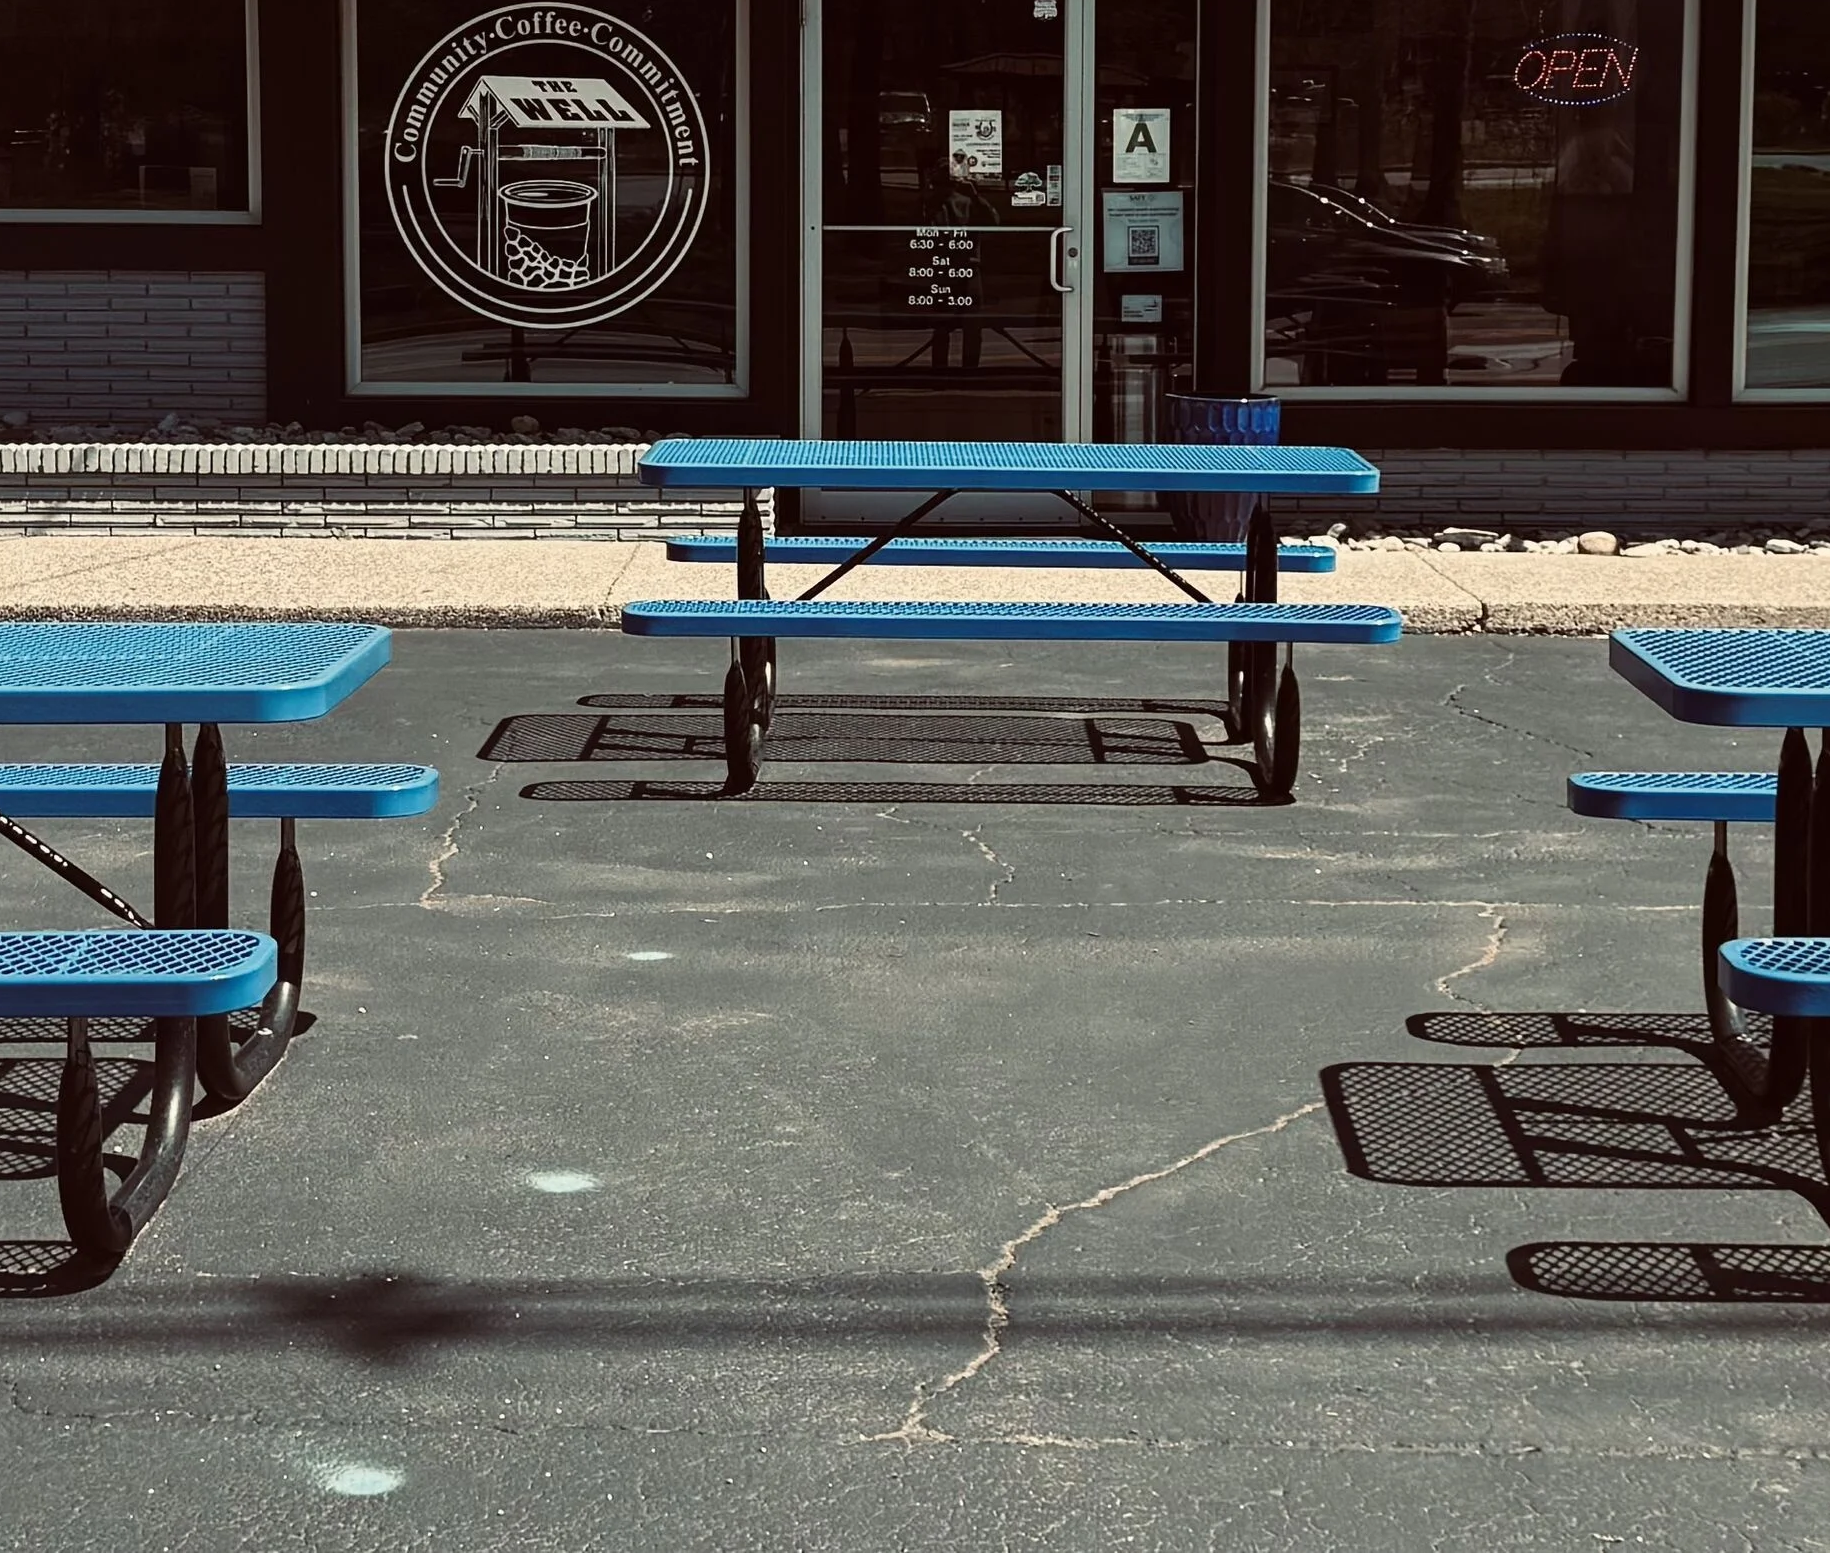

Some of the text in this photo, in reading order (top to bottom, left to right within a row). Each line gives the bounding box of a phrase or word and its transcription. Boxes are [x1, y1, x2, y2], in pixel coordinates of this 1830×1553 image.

[1514, 47, 1639, 89] OPEN
[531, 80, 578, 93] THE
[510, 98, 636, 121] WELL
[1125, 122, 1157, 153] A
[916, 228, 939, 237] Mon
[910, 239, 934, 249] 6:30
[949, 240, 973, 250] 6:00
[932, 256, 950, 266] Sat
[909, 267, 934, 277] 8:00
[948, 268, 973, 278] 6:00
[931, 284, 951, 294] Sun
[908, 295, 933, 305] 8:00
